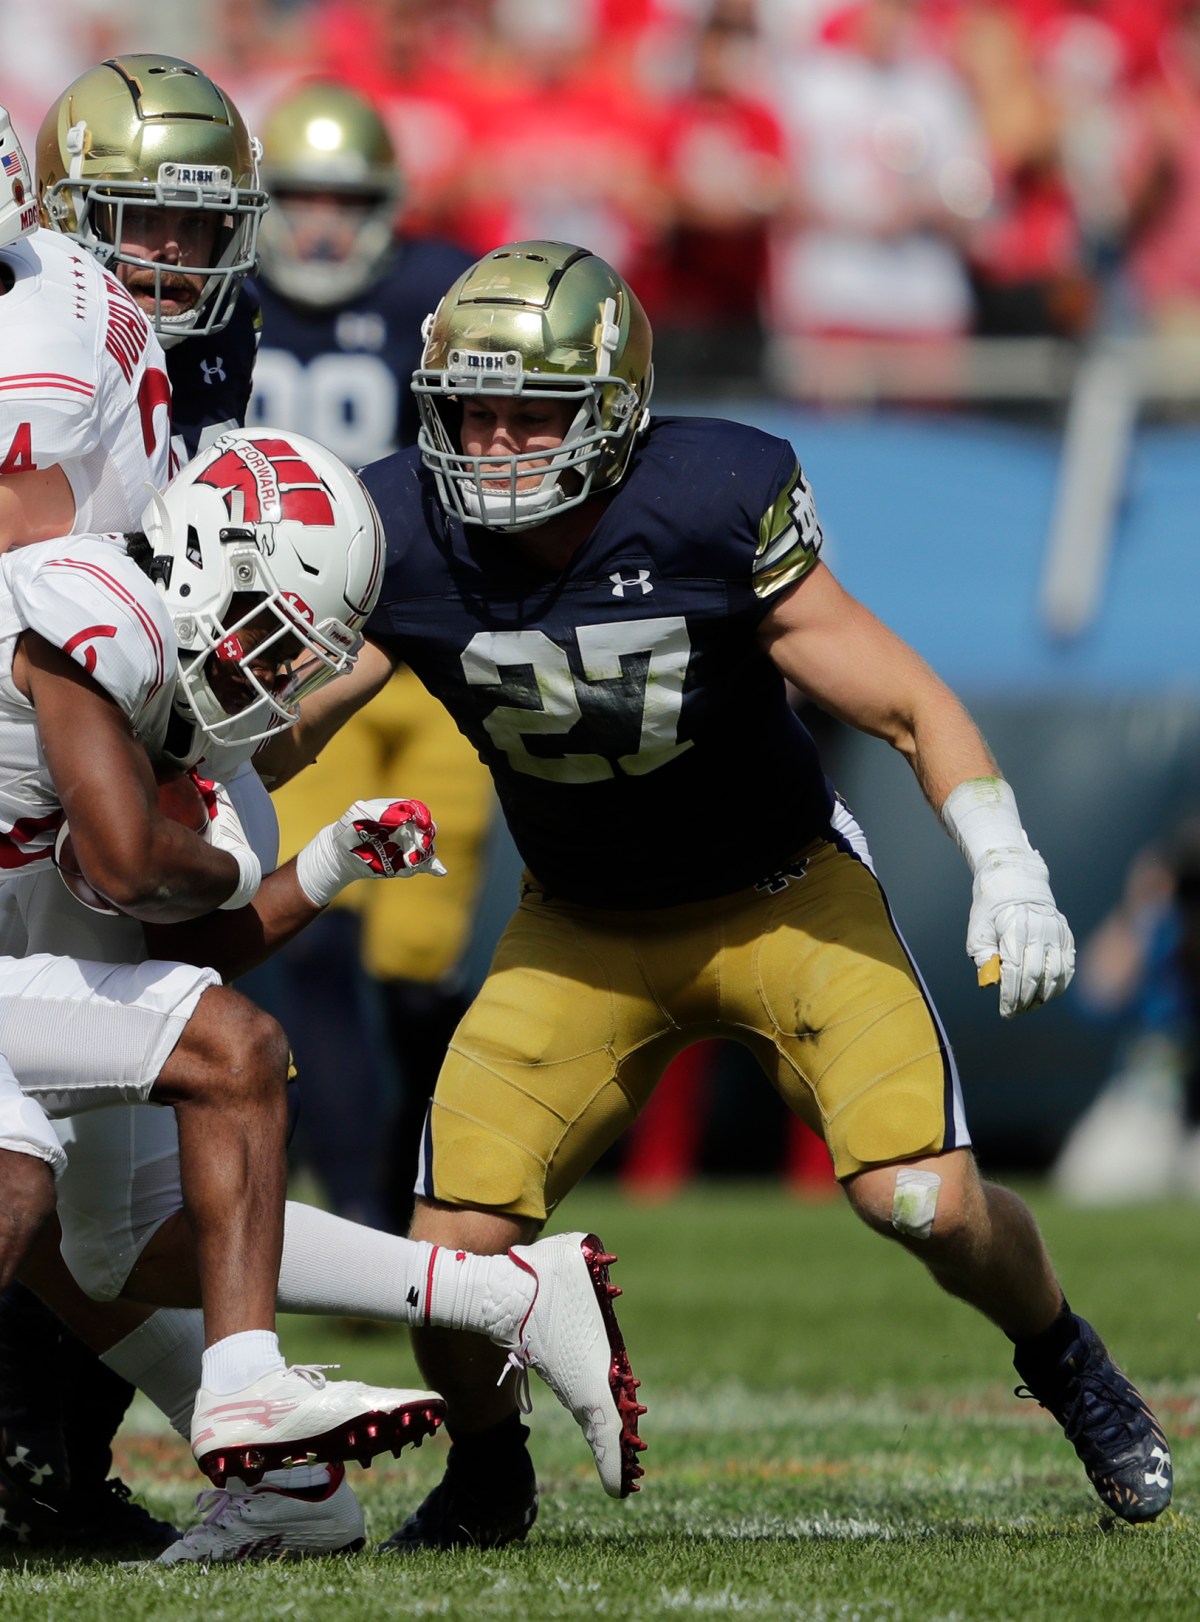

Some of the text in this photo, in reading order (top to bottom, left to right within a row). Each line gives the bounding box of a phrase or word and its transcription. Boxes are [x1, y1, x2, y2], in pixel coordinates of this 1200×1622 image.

[178, 169, 213, 182] IRISH
[468, 355, 503, 368] IRISH
[460, 616, 695, 785] 27
